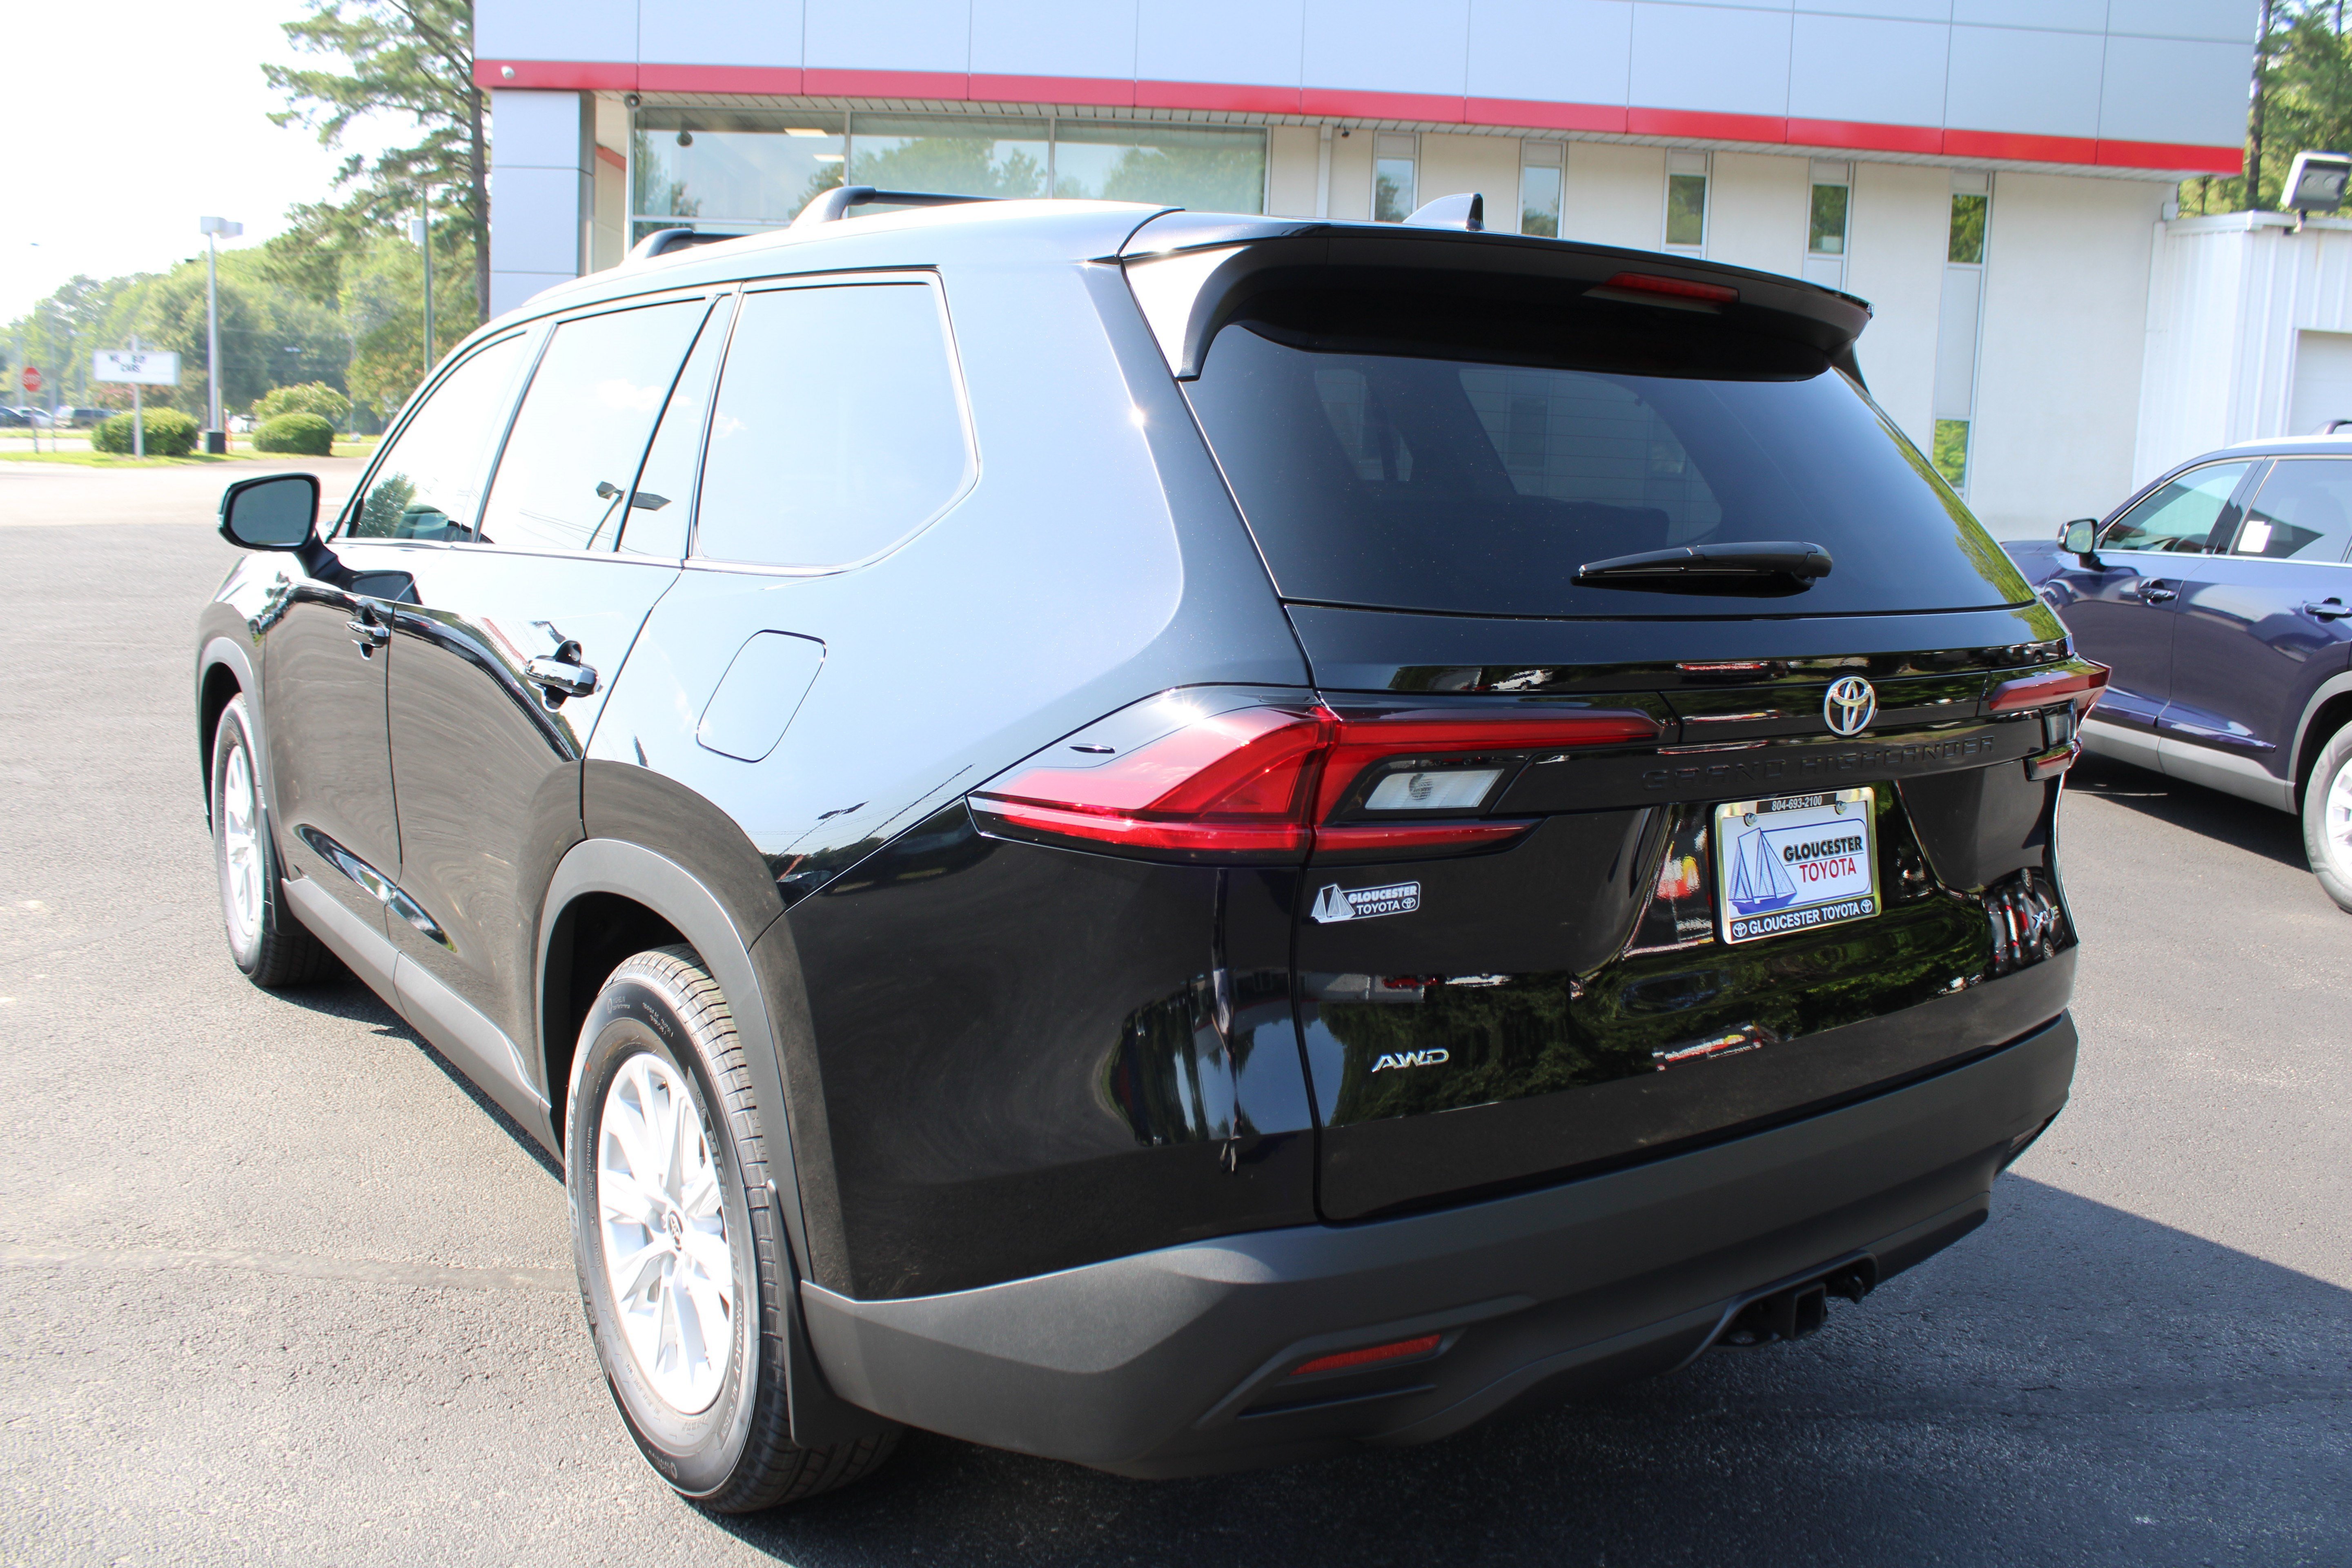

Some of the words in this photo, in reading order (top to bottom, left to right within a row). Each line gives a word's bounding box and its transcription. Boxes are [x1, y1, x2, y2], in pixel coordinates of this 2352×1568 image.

[1642, 758, 1786, 791] GRAND
[1801, 735, 1995, 775] HIGHLANDER
[1771, 795, 1822, 812] 804-693-2100
[1783, 835, 1863, 862] GLOUCESTER
[1799, 857, 1856, 883] TOYOTA
[1348, 885, 1418, 904] GLOUCESTER
[1356, 900, 1401, 915] TOYOTA
[1749, 909, 1820, 935] GLOUCESTER
[1823, 902, 1860, 921] TOYOTA
[2032, 905, 2060, 929] XLE
[1372, 1048, 1449, 1073] AWD
[706, 1130, 740, 1276] MICHELIN
[734, 1299, 743, 1379] PRIMACY
